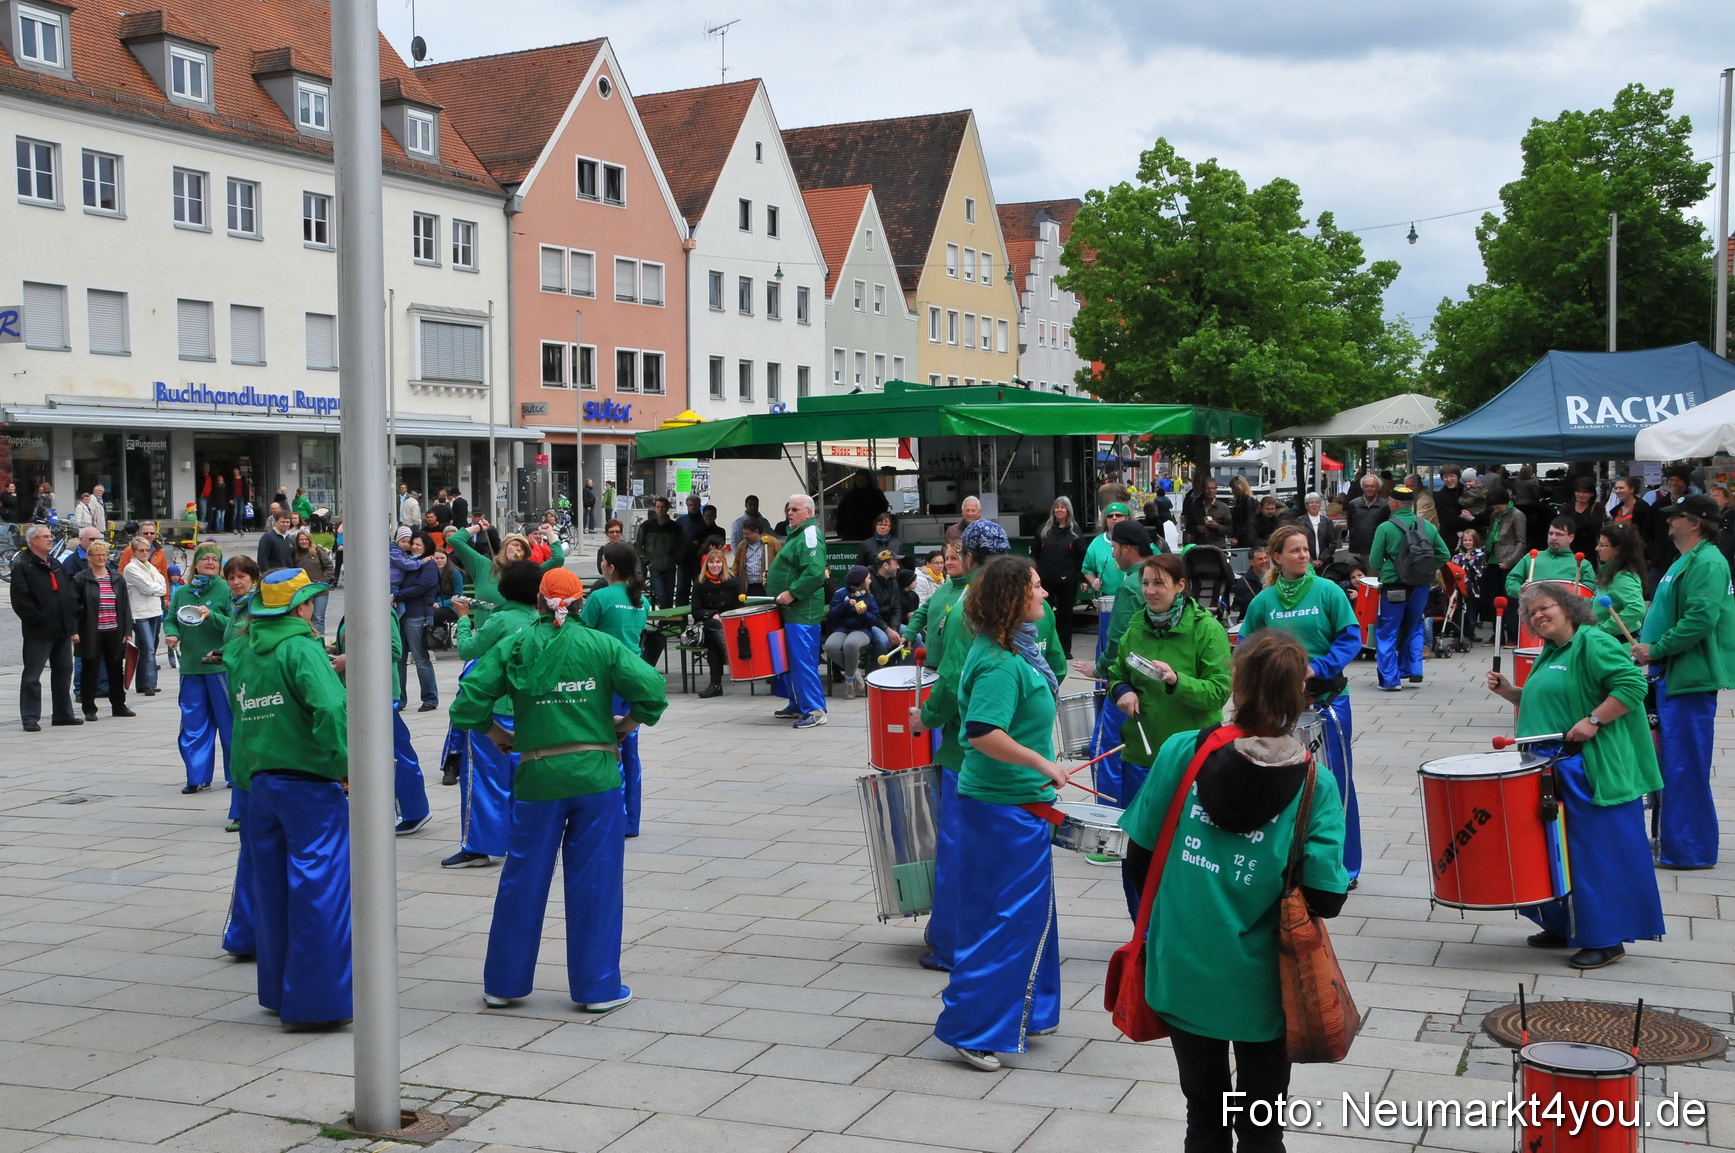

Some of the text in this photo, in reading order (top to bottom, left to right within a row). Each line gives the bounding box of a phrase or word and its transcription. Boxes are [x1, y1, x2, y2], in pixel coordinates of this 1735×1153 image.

[154, 381, 289, 413] Buchhandlung
[135, 440, 167, 451] Rupprecht
[826, 552, 858, 560] erantwor
[1276, 605, 1320, 619] sarará
[1190, 804, 1220, 829] Fa
[1184, 835, 1257, 871] CD 12 €
[1438, 807, 1492, 874] sarará
[1181, 849, 1253, 886] Button 1 €
